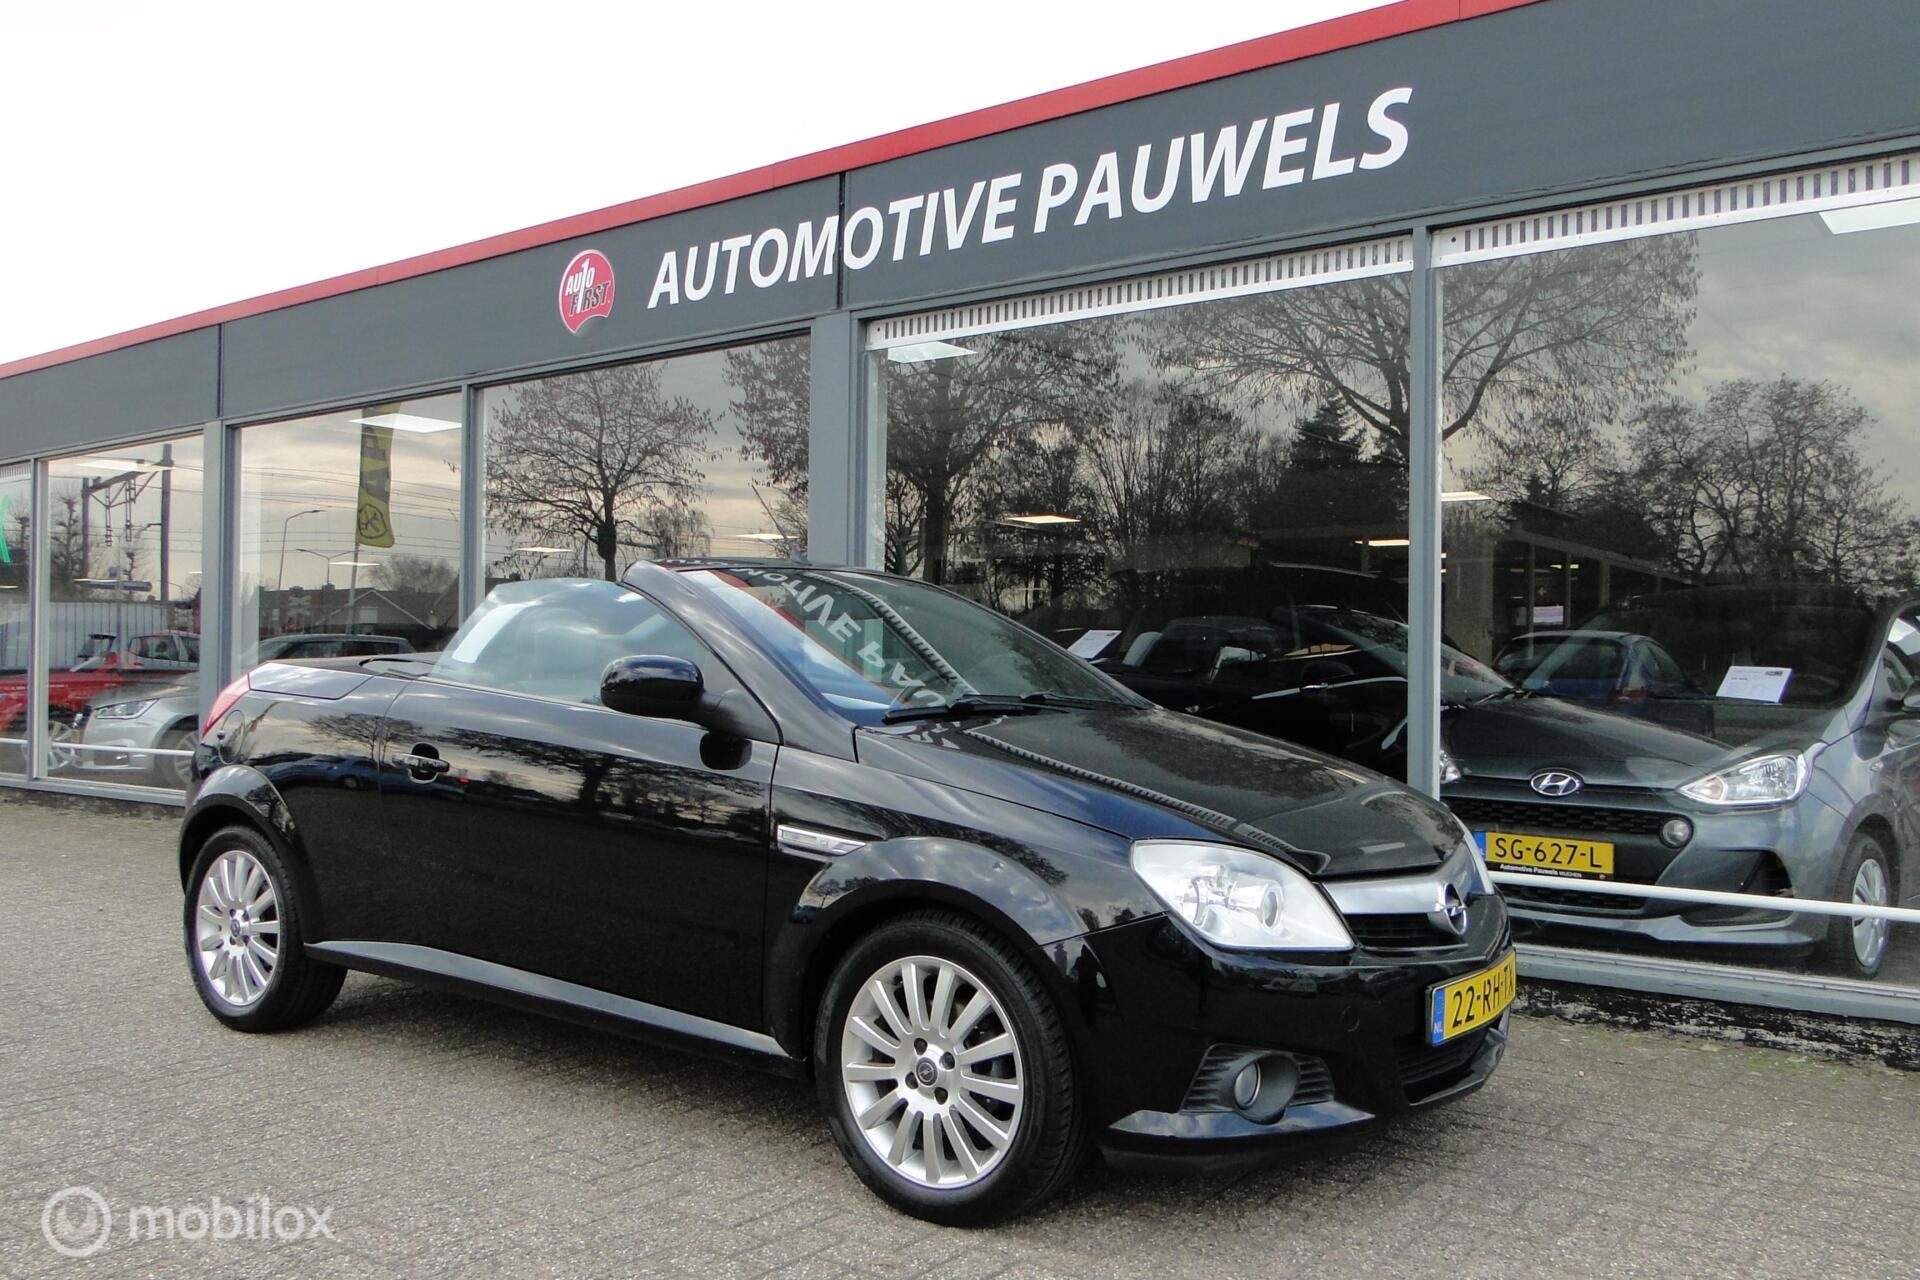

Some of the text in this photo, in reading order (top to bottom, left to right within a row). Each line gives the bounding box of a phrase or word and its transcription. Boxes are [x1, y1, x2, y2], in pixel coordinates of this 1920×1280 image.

[647, 87, 1413, 309] AUTOMOTIVE PAUWELS
[1494, 837, 1602, 869] SG-627-L
[1452, 962, 1514, 1029] 22-RH-TX
